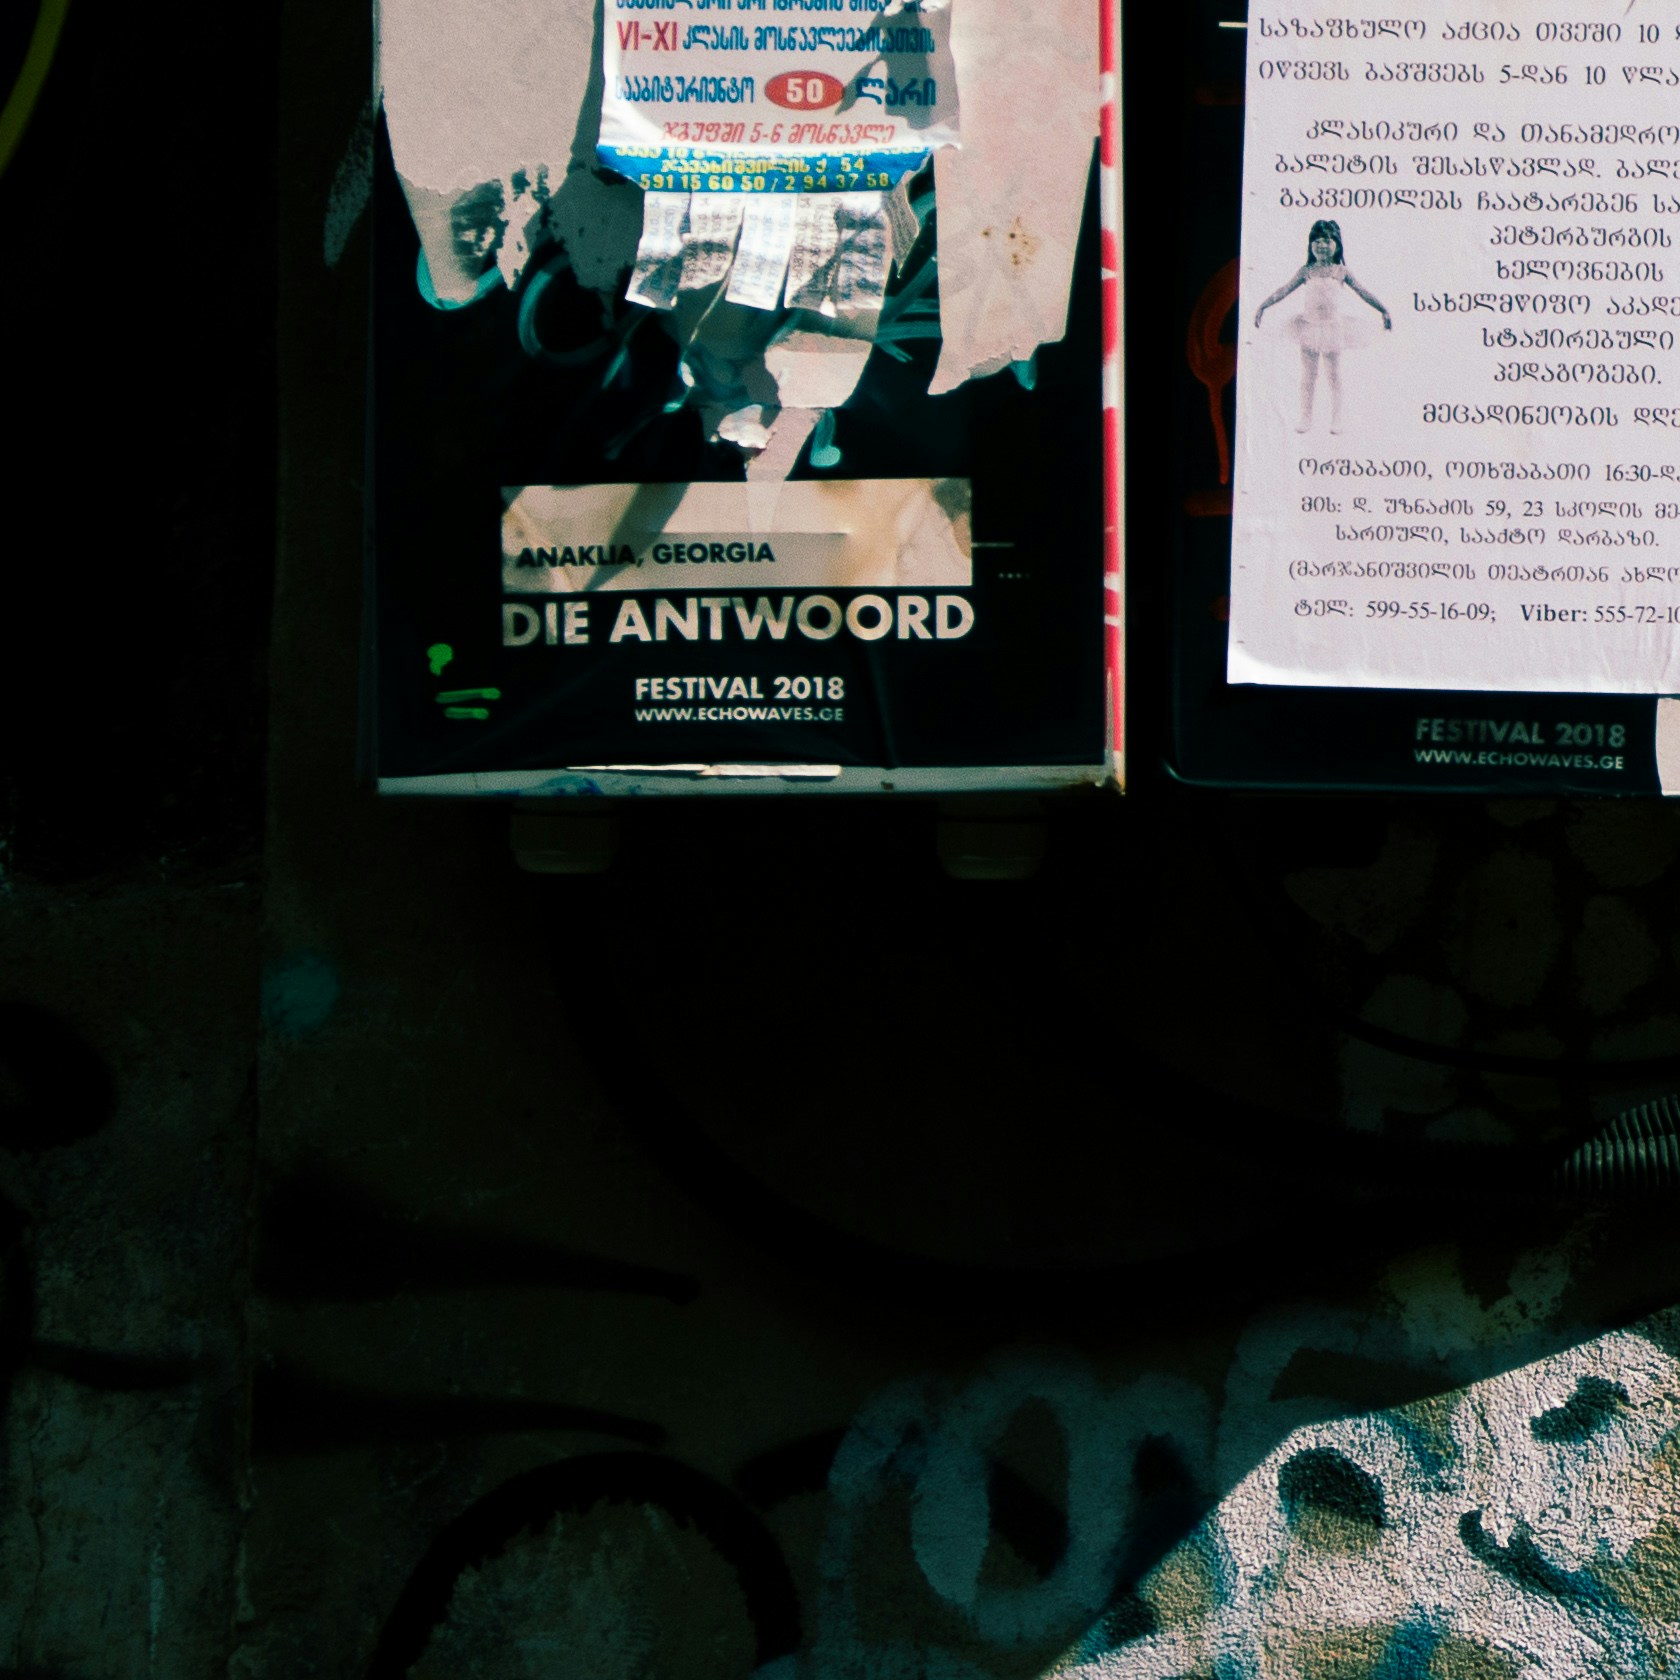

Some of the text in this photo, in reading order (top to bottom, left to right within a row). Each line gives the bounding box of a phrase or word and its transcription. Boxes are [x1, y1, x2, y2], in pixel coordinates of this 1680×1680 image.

[617, 21, 678, 51] VI-XI
[682, 25, 749, 51] კლასის
[1259, 17, 1427, 40] საზაფხულო
[1441, 21, 1521, 42] აქცია
[1535, 21, 1622, 43] თვეში
[1639, 23, 1660, 44] 10
[1258, 60, 1350, 81] იწვევს
[1365, 61, 1485, 84] ბავშვებს
[1499, 64, 1568, 85] 5-დან
[1585, 65, 1607, 86] 10
[615, 75, 937, 107] სააბიტურიენტო 50 ლარი
[750, 122, 782, 144] 5-6
[1305, 119, 1458, 142] კლასიკური
[1473, 122, 1506, 143] და
[841, 158, 864, 172] 54
[1274, 153, 1398, 175] ბალეტის
[1411, 155, 1601, 179] შესასწავლად.
[639, 173, 673, 190] 591
[681, 174, 701, 190] 15
[708, 174, 734, 191] 60
[740, 174, 765, 191] 50
[785, 174, 795, 191] 2
[803, 174, 827, 190] 94
[836, 173, 859, 190] 37
[866, 172, 889, 188] 58
[1279, 187, 1463, 211] გაკვეთილებს
[1477, 190, 1638, 214] ჩაატარებენ
[1489, 225, 1672, 248] პეტერბურგის
[1495, 259, 1664, 283] ხელოვნების
[1412, 291, 1591, 315] სახელმწიფო
[1481, 327, 1674, 351] სტაჟირებული
[1493, 361, 1662, 385] პედაგოგები.
[1422, 403, 1619, 427] მეცადინეობის
[1298, 458, 1433, 481] ორშაბათი,
[1445, 460, 1591, 481] ოთხშაბათი
[1300, 496, 1342, 514] მის:
[1352, 496, 1372, 514] დ.
[1383, 497, 1474, 516] უზნაძის
[1485, 499, 1512, 520] 59,
[1522, 500, 1544, 518] 23
[1555, 500, 1643, 519] სკოლის
[1335, 524, 1660, 547] სართული, სააქტო დარბაზი.
[515, 542, 776, 568] ANAKLIA, GEORGIA
[1288, 560, 1476, 581] (მარჯანიშვილის
[1487, 564, 1609, 583] თეატრთან
[502, 595, 975, 646] DIE ANTWOORD
[1293, 599, 1354, 618] ტელ:
[1365, 600, 1496, 624] 599-55-16-09;
[1520, 603, 1587, 623] Viber:
[635, 676, 846, 700] FESTIVAL 2018
[634, 707, 845, 722] WWW.ECHOWAVES.GE
[1416, 718, 1626, 748] FESTIVAL 2018
[1414, 748, 1625, 770] WWW.ECHOWAVES.GE
